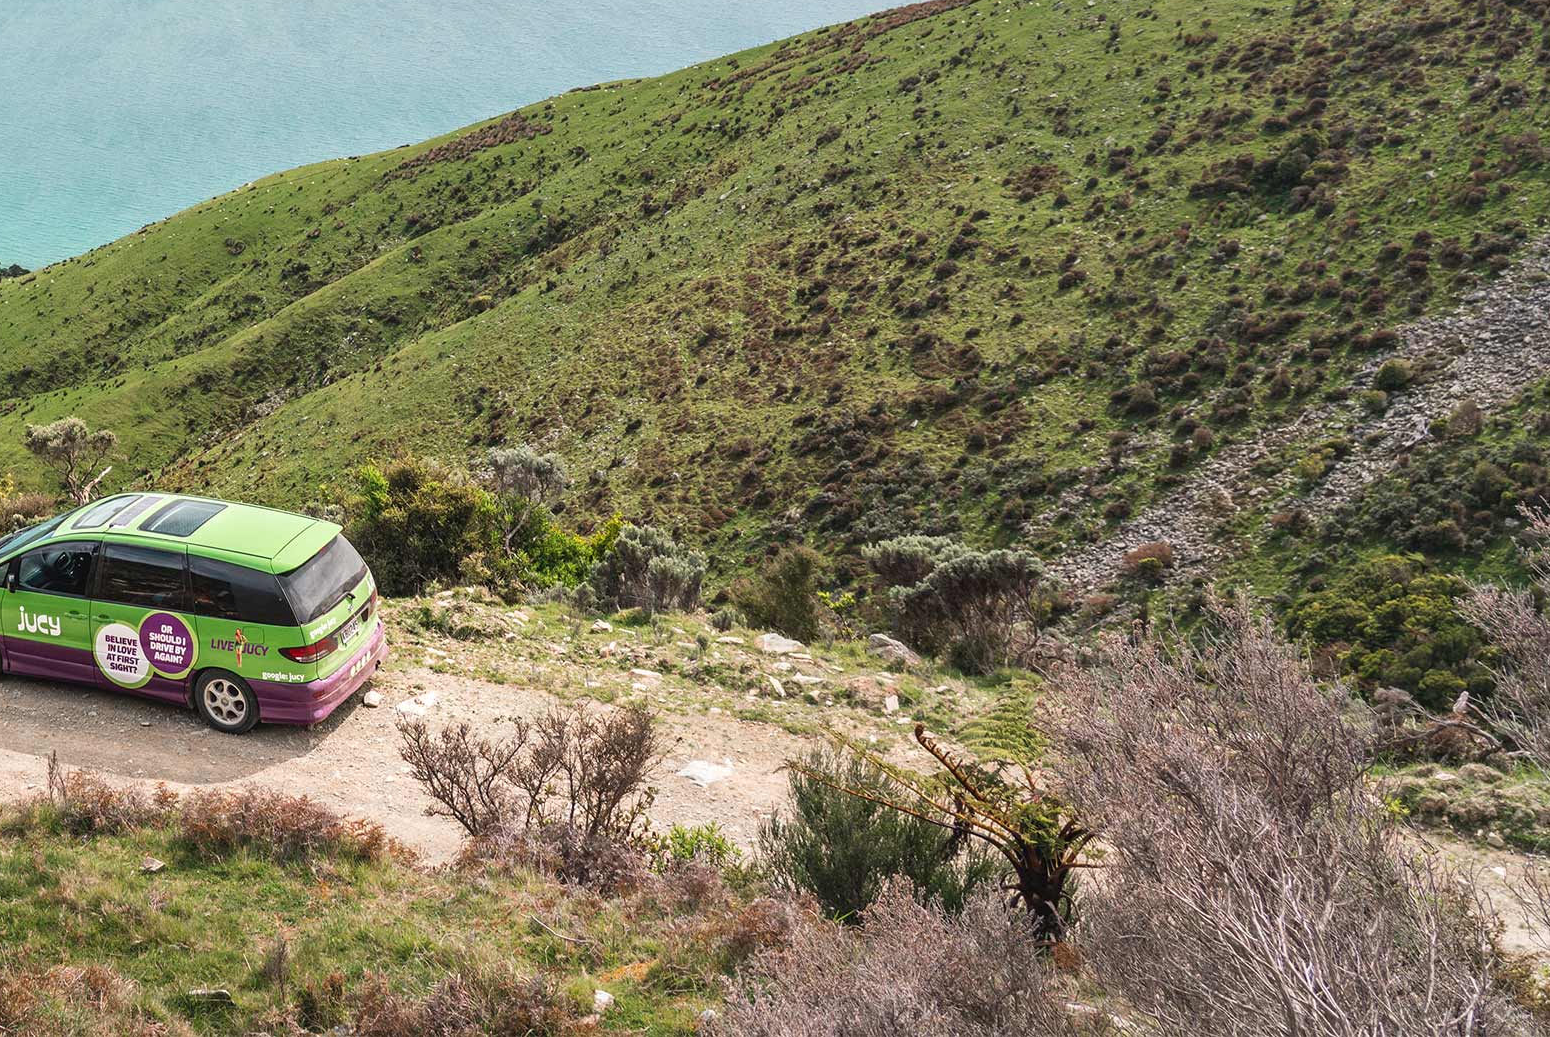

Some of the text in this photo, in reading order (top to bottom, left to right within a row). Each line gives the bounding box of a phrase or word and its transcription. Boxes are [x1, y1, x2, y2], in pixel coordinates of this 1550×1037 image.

[18, 606, 61, 636] jucy
[161, 625, 173, 634] OR
[105, 635, 137, 647] BELIEVE
[149, 632, 186, 646] SHOULD I
[108, 644, 137, 656] IN LOVE
[150, 642, 186, 655] DRIVE BY
[211, 639, 269, 656] LIVE JUCY
[107, 653, 139, 665] AT FIRST
[154, 652, 183, 664] AGAIN?
[110, 663, 137, 674] SIGHT?
[289, 673, 304, 682] jucy
